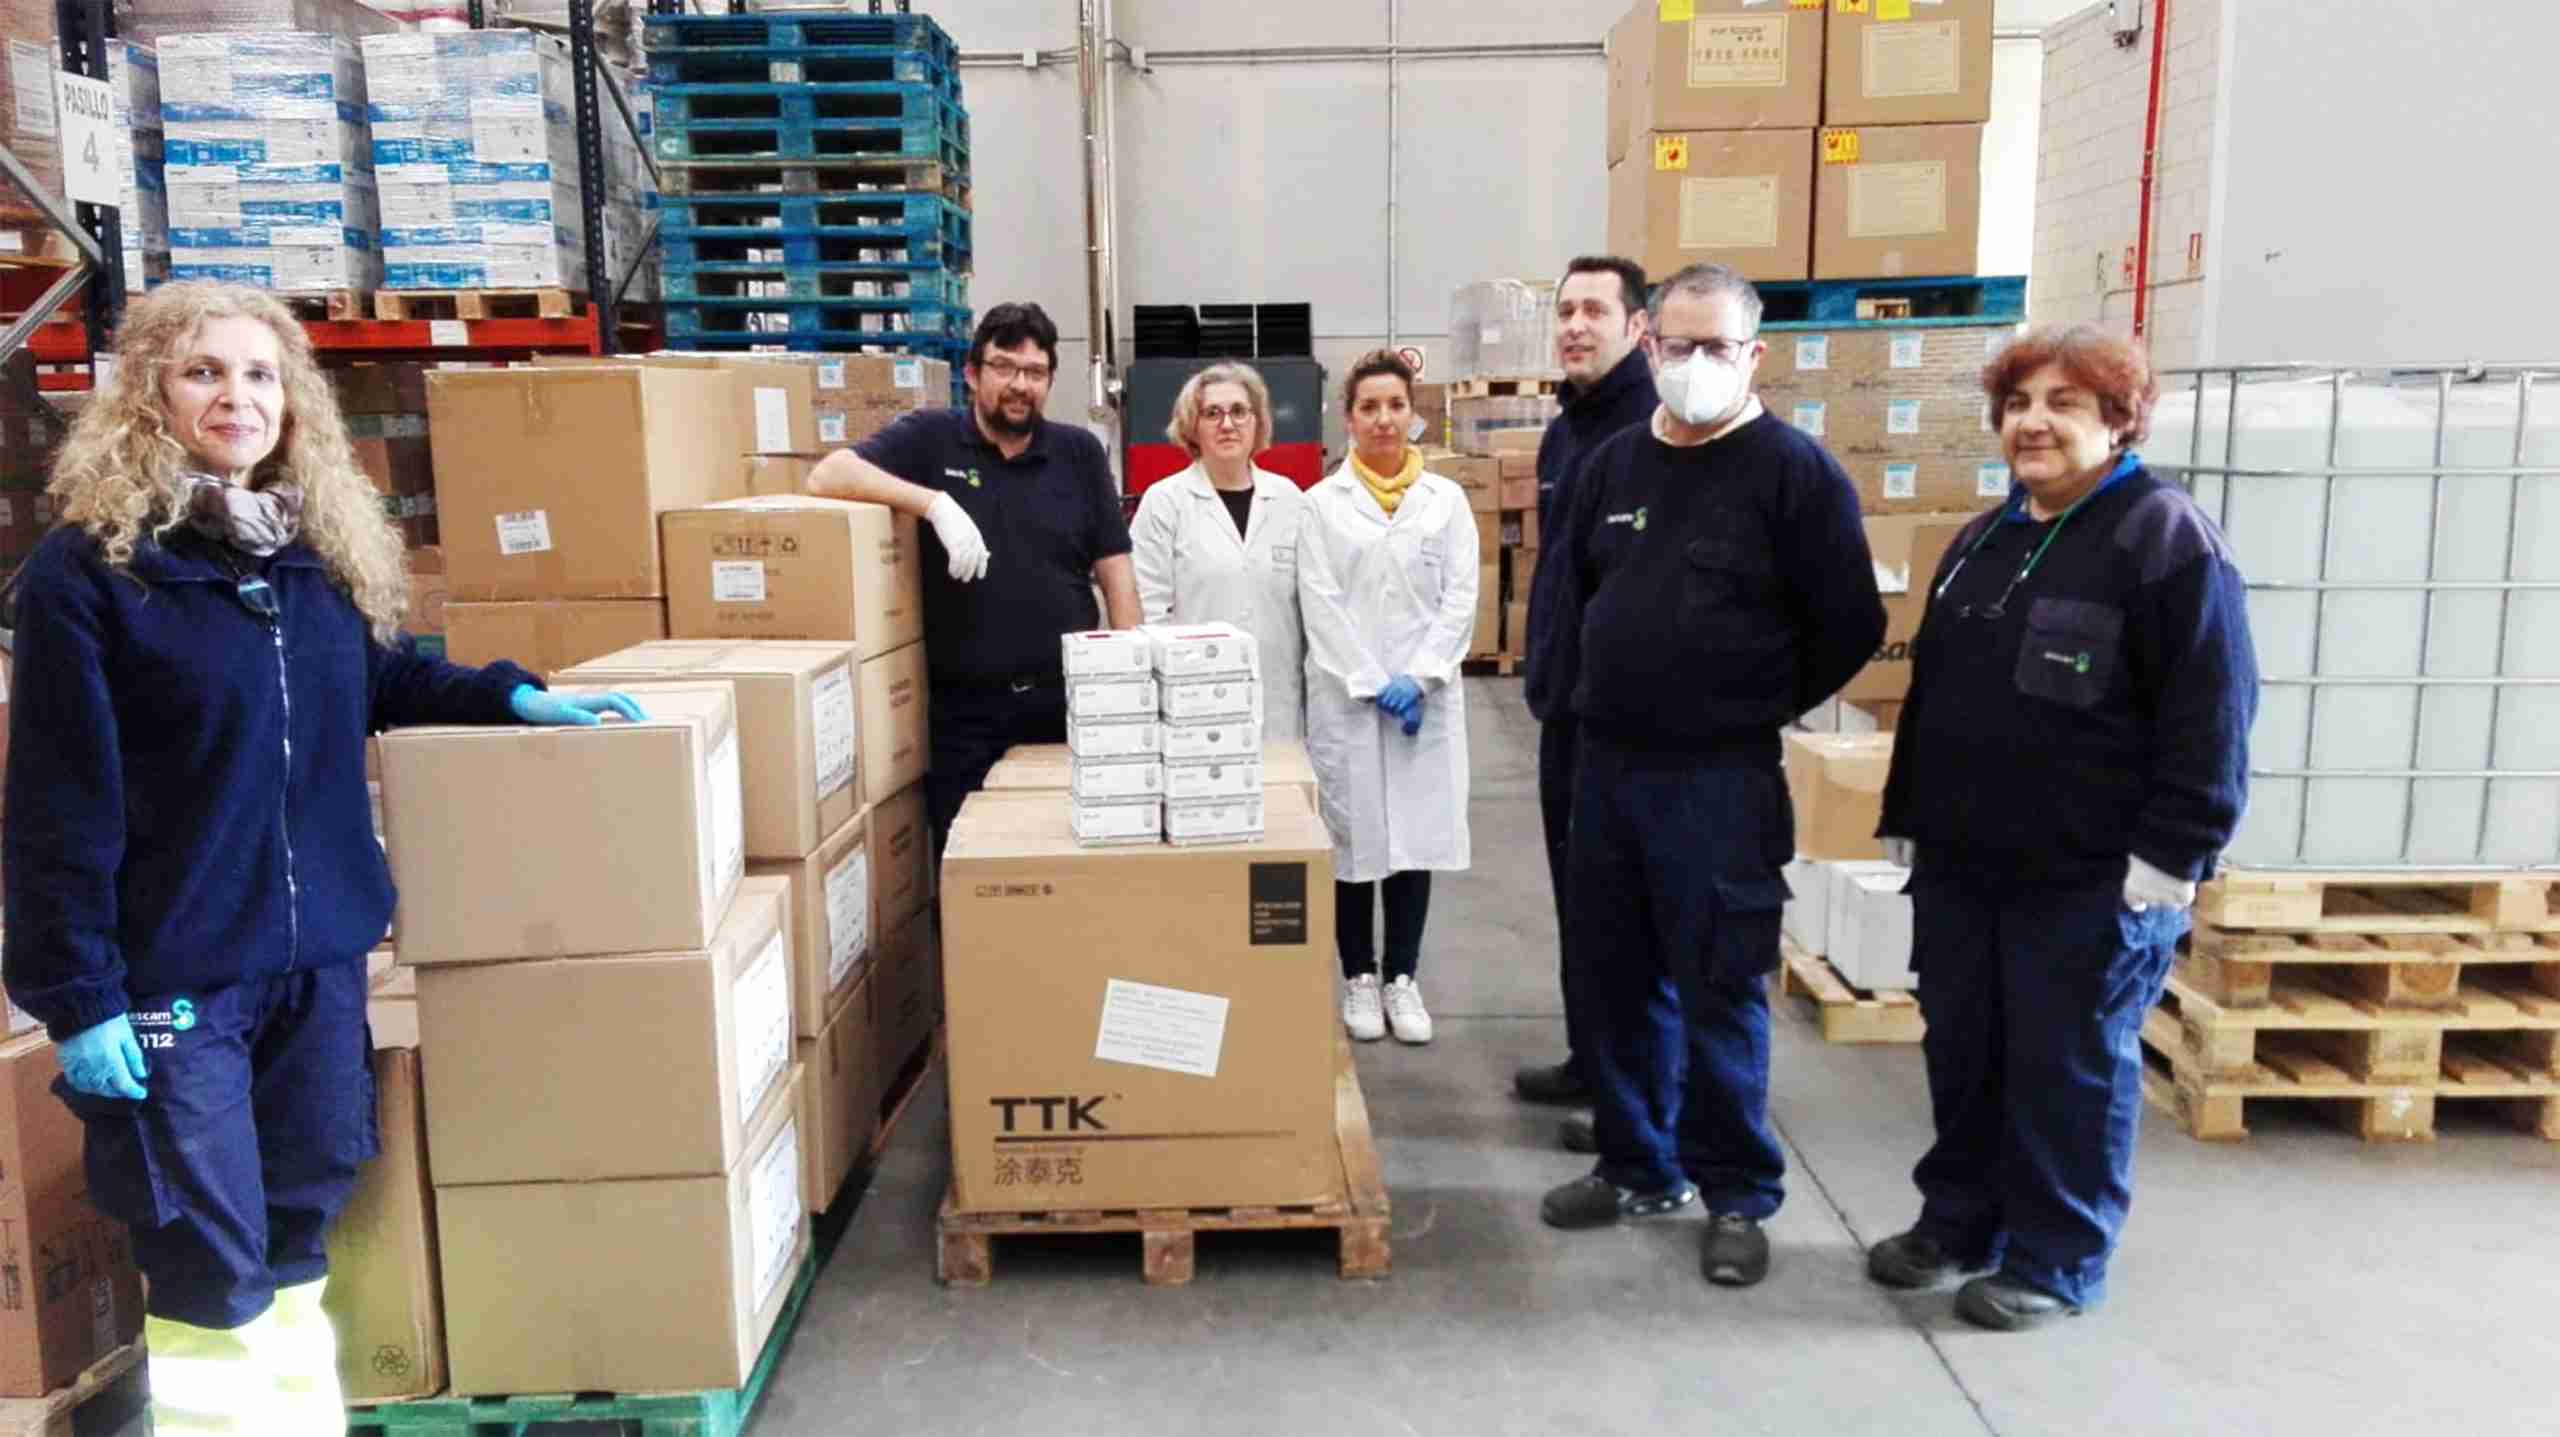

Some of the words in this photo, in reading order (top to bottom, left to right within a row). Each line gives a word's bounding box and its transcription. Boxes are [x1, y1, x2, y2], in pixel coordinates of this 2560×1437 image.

[64, 83, 109, 120] PASILLO
[82, 131, 99, 173] 4
[140, 1033, 174, 1048] 112
[989, 1096, 1107, 1132] TTK
